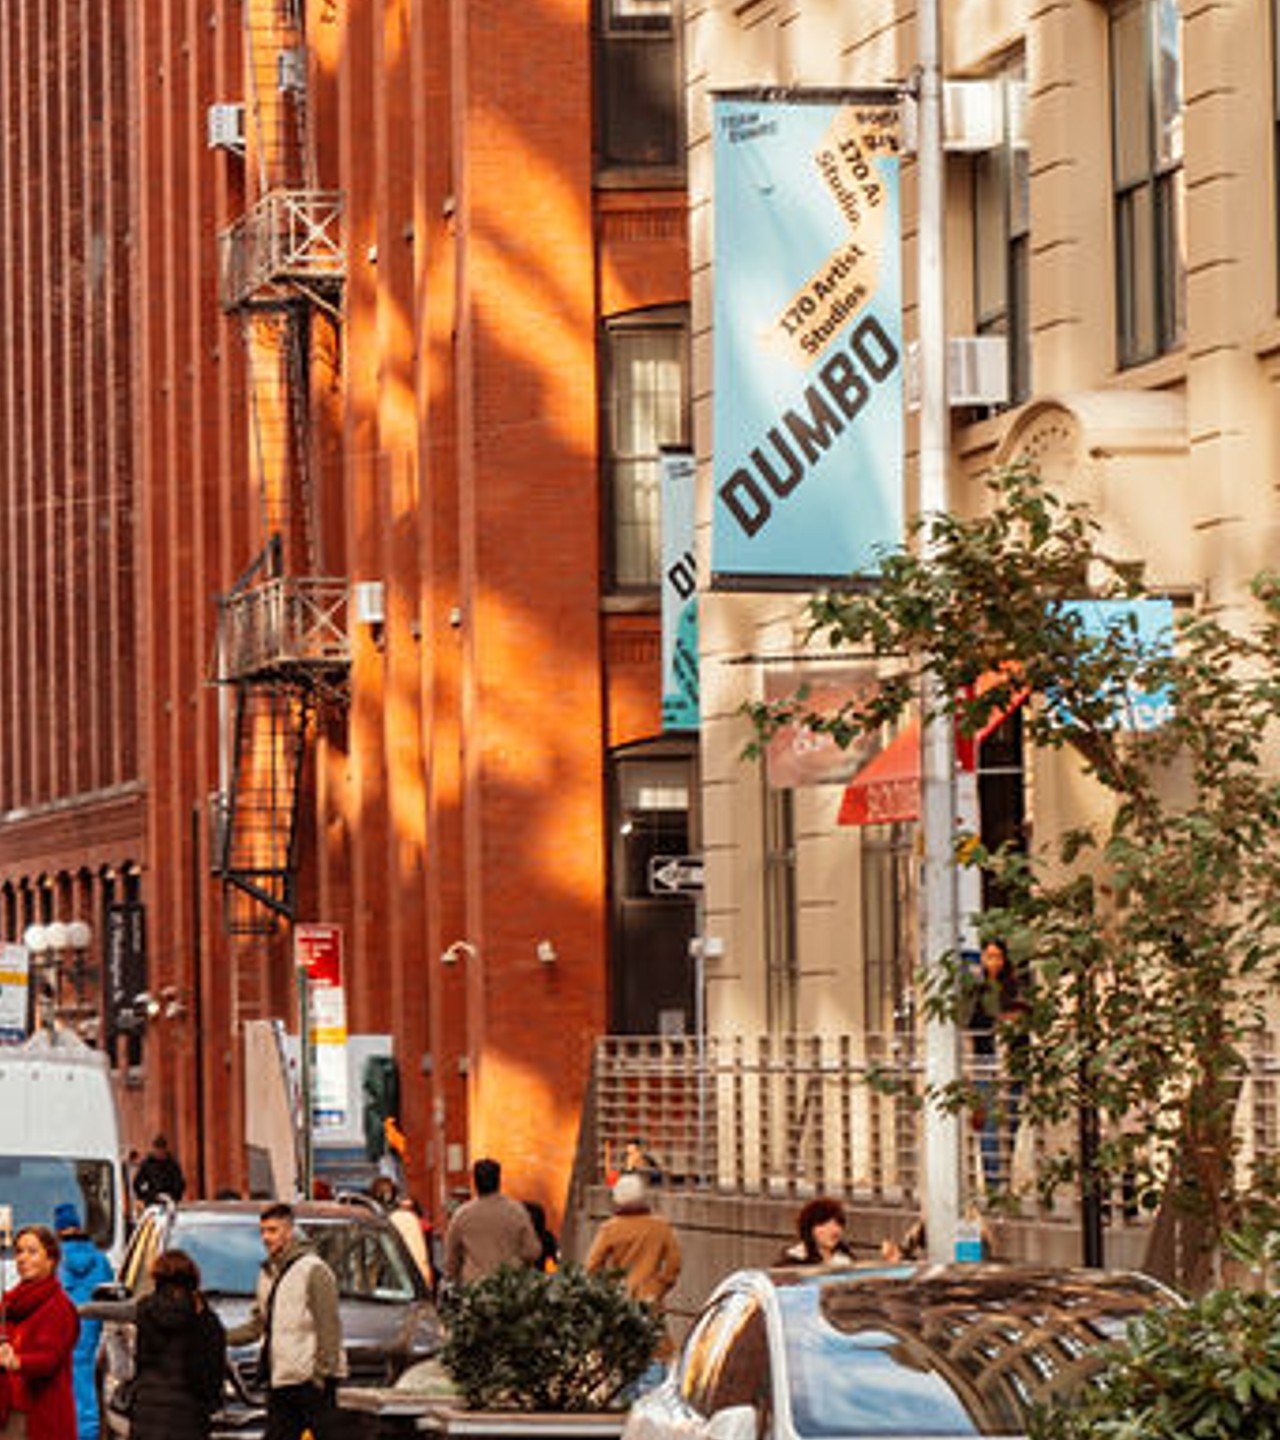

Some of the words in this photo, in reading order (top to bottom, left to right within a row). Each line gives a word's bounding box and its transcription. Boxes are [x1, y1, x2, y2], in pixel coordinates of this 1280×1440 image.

[780, 295, 818, 338] 170
[811, 242, 867, 302] Artist
[799, 282, 869, 356] Studios
[718, 314, 900, 540] DUMBO
